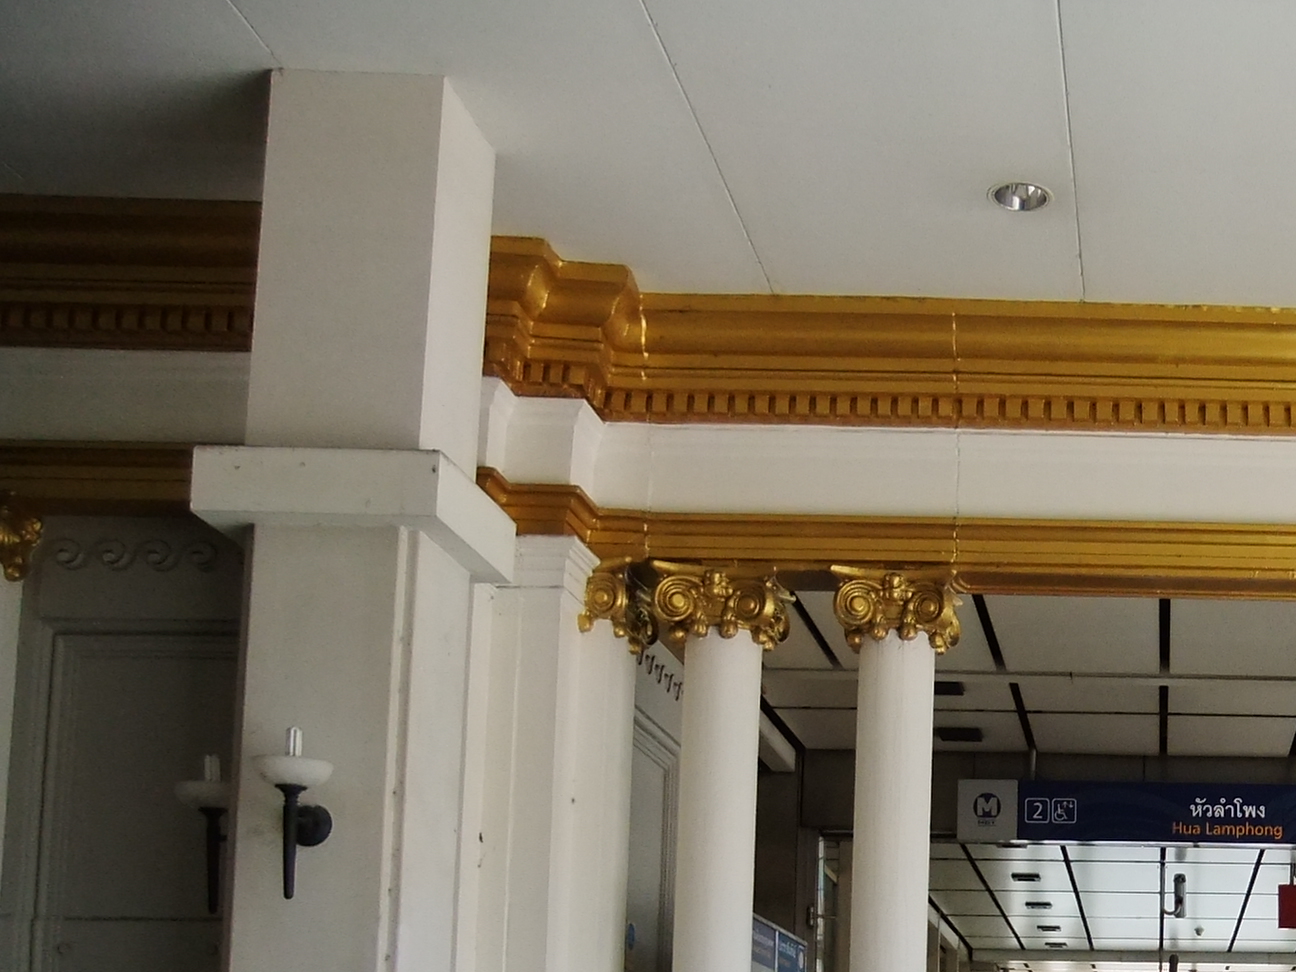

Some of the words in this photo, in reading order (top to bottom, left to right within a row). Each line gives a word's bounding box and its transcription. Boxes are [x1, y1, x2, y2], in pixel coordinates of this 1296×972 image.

[1032, 802, 1043, 819] 2
[1189, 797, 1266, 818] หัวลำโพง
[1172, 821, 1201, 835] Hua
[1205, 822, 1283, 840] Lamphong
